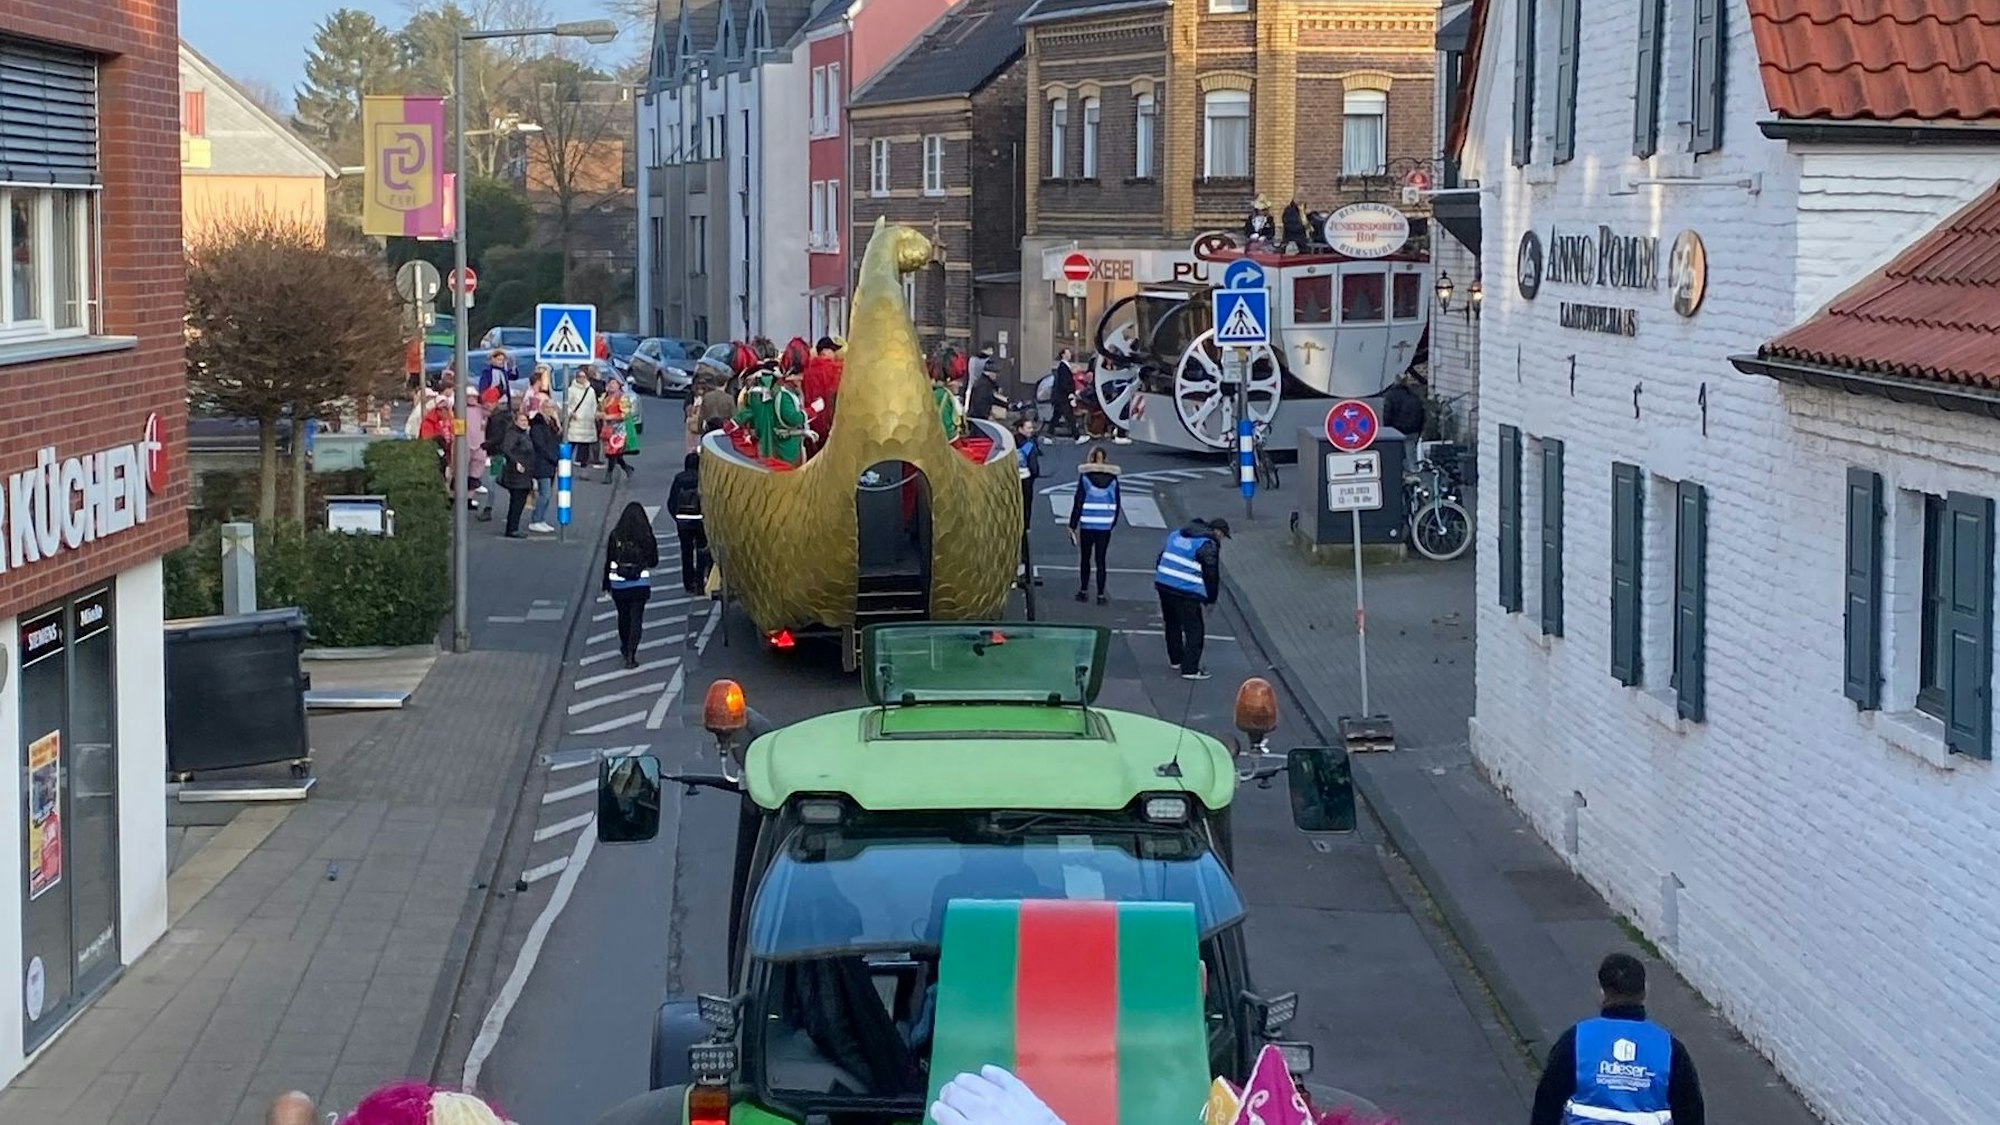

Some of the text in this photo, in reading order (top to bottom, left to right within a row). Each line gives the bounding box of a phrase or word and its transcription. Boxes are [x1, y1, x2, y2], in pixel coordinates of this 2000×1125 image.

[1338, 203, 1398, 219] RESTAURANT
[1328, 222, 1405, 231] JUNKERSDORFER
[1356, 232, 1377, 242] HOF
[1339, 243, 1393, 256] BIERSTUBE
[1545, 224, 1593, 286] ANNO
[9, 446, 147, 568] KÜCHEN
